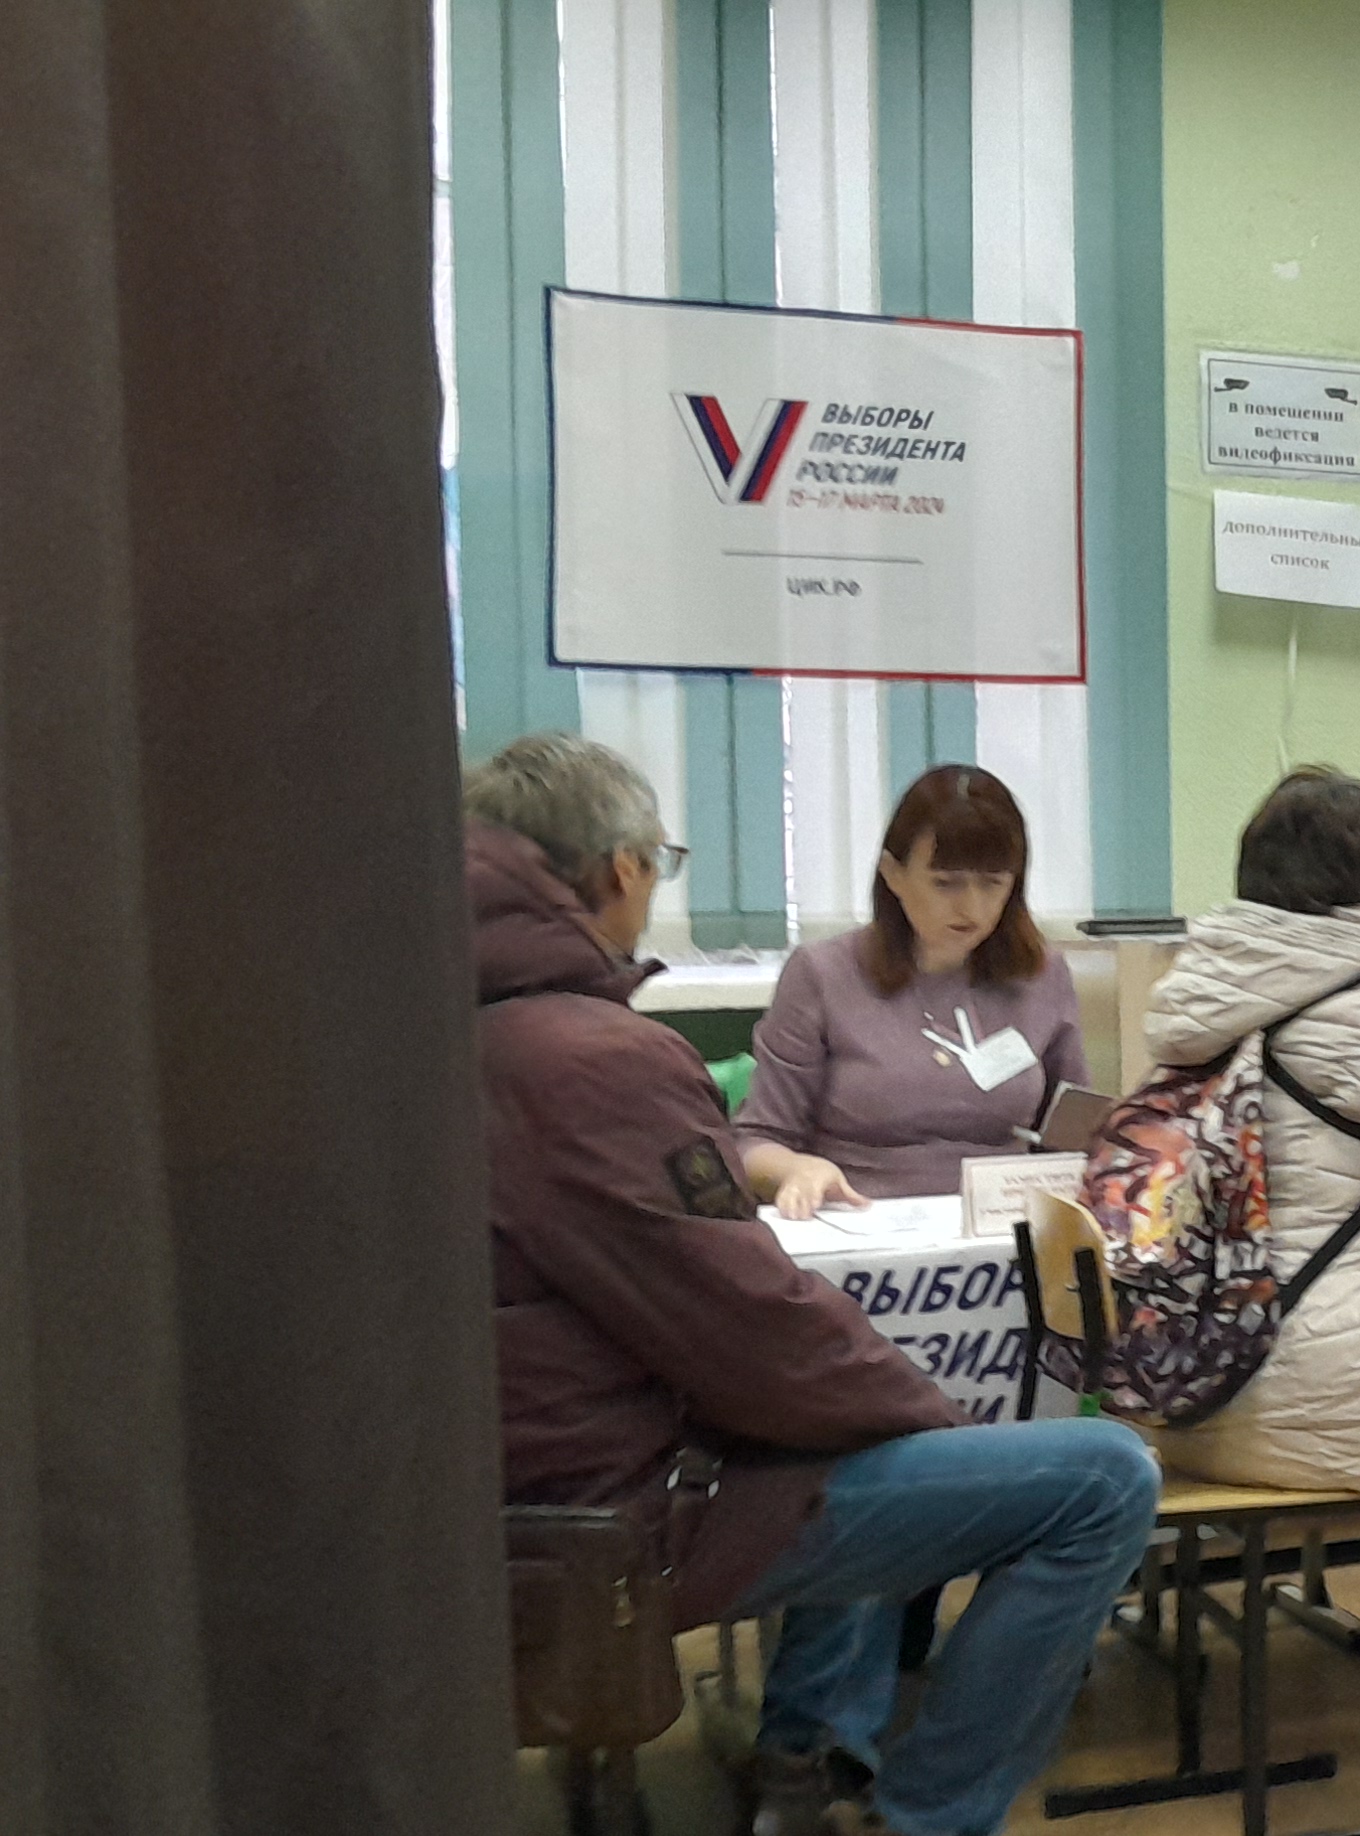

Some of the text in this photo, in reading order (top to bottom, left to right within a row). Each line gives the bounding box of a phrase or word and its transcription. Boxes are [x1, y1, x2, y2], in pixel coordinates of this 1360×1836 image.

[820, 402, 935, 431] ВЫБОРЫ
[1228, 402, 1344, 423] в помещении
[1254, 426, 1320, 442] ведется
[808, 431, 967, 463] ПРЕЗИДЕНТА
[1217, 445, 1356, 468] видеофиксация
[796, 459, 899, 485] РОССИИ
[840, 491, 900, 513] МАРТА
[902, 494, 945, 515] 2024
[1270, 553, 1330, 571] список
